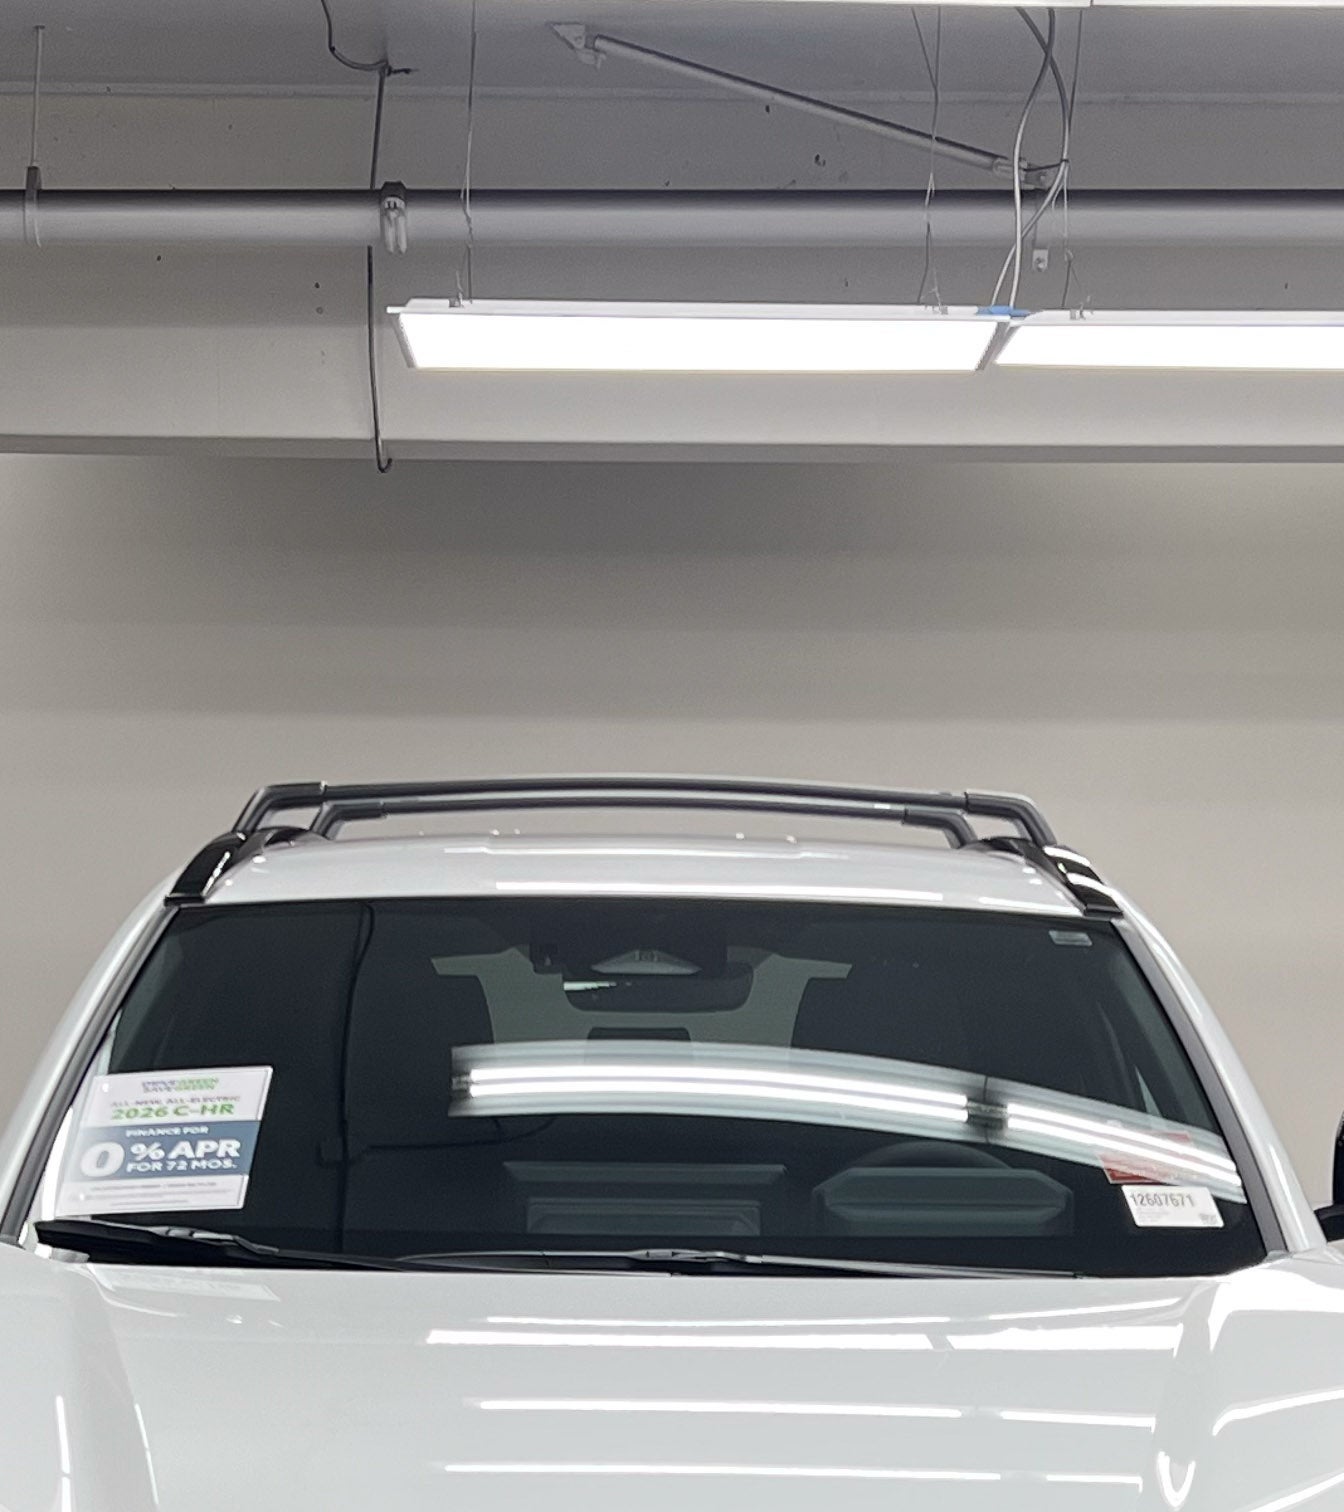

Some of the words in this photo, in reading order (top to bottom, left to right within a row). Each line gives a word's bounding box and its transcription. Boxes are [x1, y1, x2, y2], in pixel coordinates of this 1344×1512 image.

[111, 1106, 169, 1120] 2026
[173, 1104, 235, 1117] C-HR
[125, 1128, 182, 1138] FINANCE
[183, 1126, 209, 1136] FOR
[168, 1138, 241, 1160] APR
[125, 1161, 163, 1173] FOR
[166, 1160, 188, 1171] 72
[191, 1158, 238, 1170] MOS.
